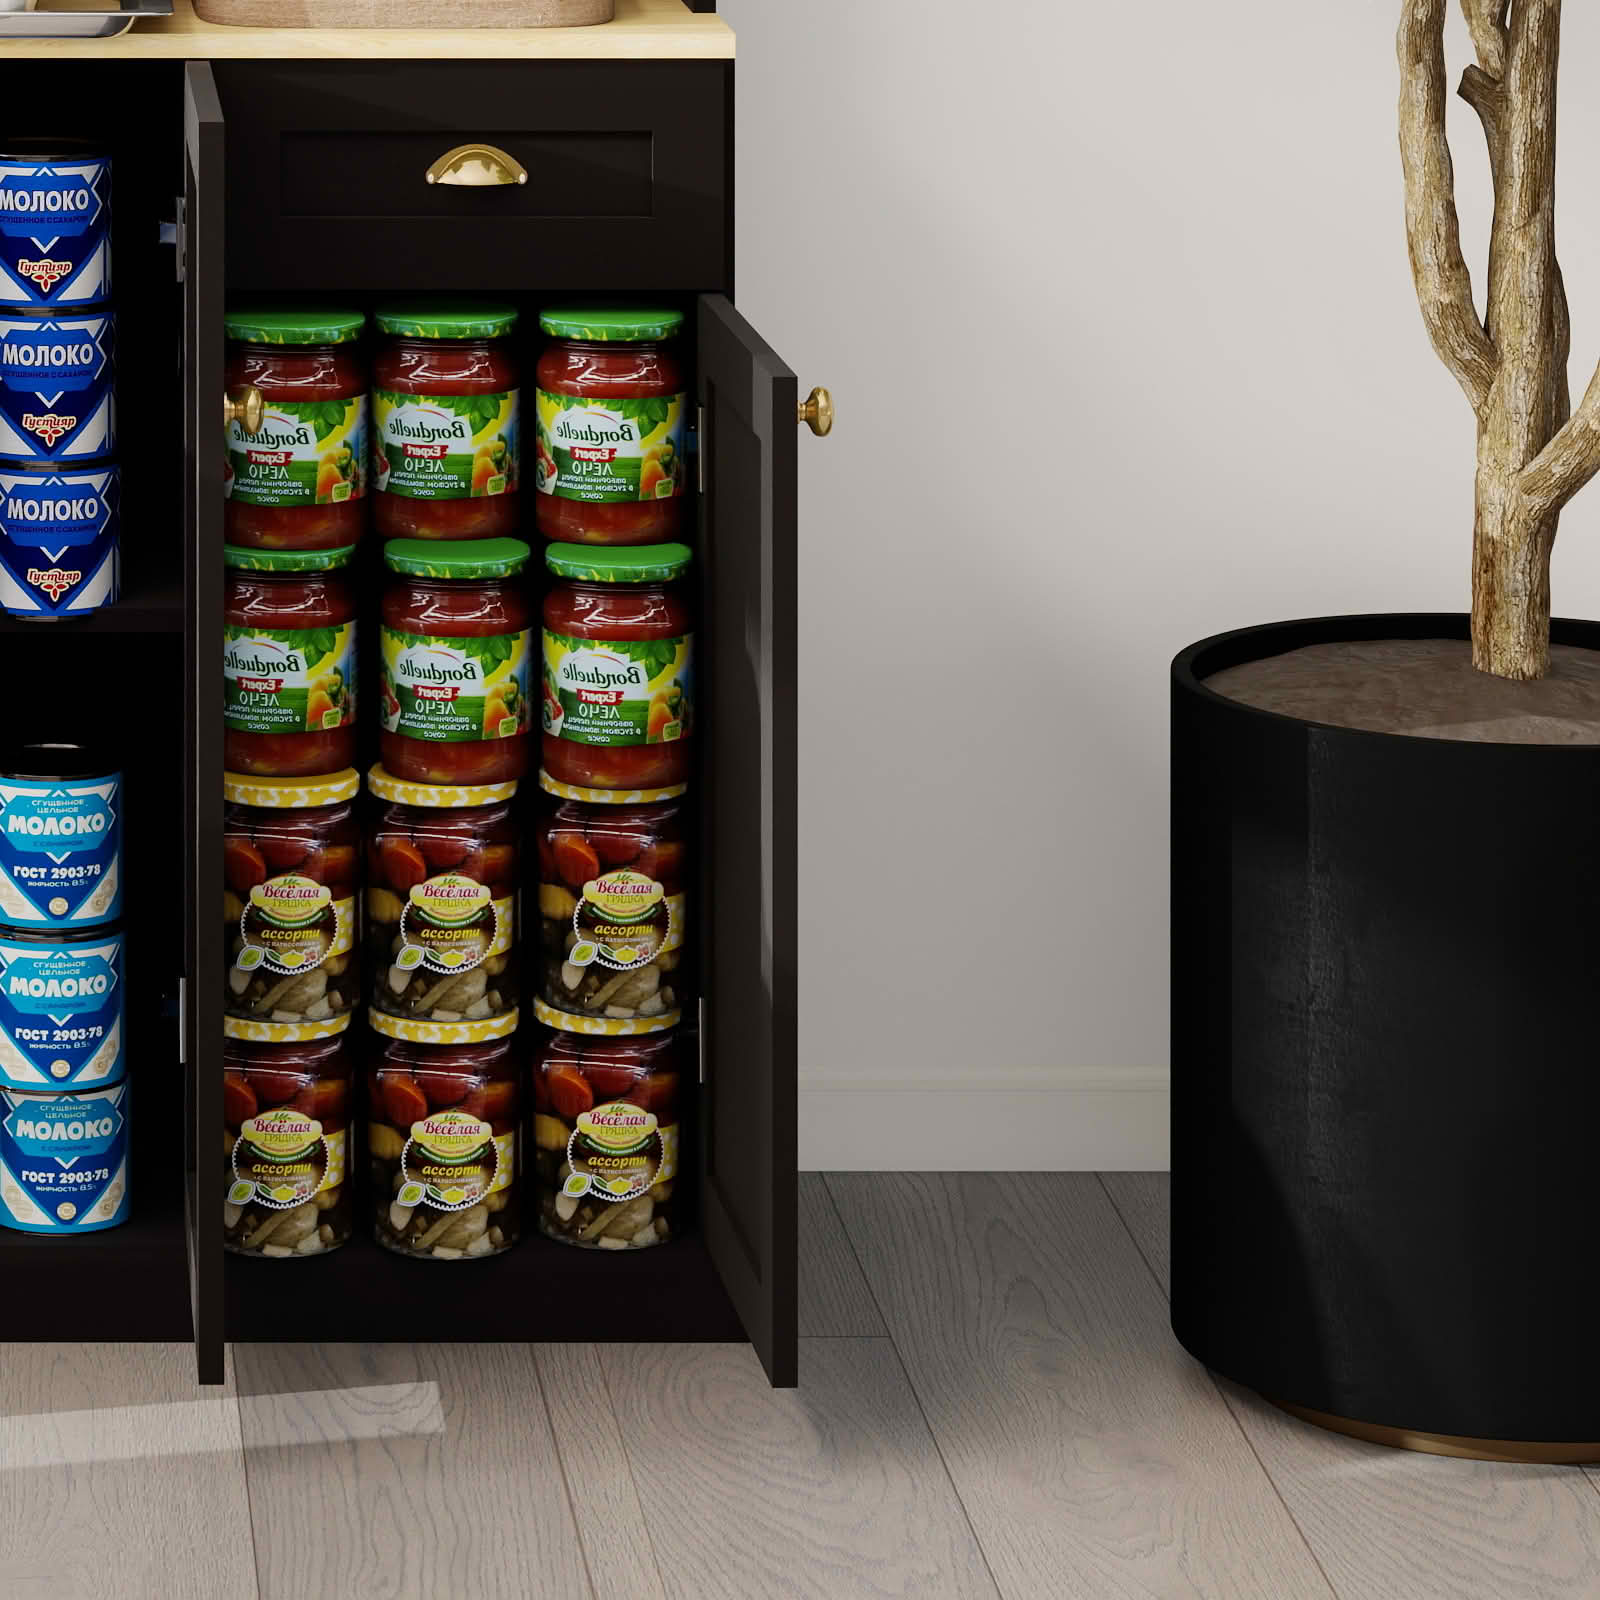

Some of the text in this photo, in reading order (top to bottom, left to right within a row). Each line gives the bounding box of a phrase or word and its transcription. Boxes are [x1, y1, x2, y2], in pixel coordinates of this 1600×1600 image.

[20, 259, 71, 276] Густияр
[3, 343, 94, 367] МОЛОКО
[24, 414, 75, 431] Густияр
[7, 497, 98, 521] МОЛОКО
[29, 568, 80, 585] Густияр
[7, 812, 105, 835] МОЛОКО
[13, 865, 47, 879] ГОСТ
[262, 885, 320, 899] Весёлая
[422, 884, 480, 898] Весёлая
[595, 880, 653, 894] Весёлая
[260, 929, 320, 942] ассорти
[420, 928, 480, 941] ассорти
[593, 924, 653, 937] ассорти
[9, 974, 107, 997] МОЛОКО
[14, 1027, 49, 1041] ГОСТ
[253, 1119, 311, 1133] Весёлая
[589, 1112, 647, 1126] Весёлая
[15, 1117, 113, 1140] МОЛОКО
[423, 1121, 481, 1135] Весёлая
[251, 1163, 311, 1176] ассорти
[587, 1156, 647, 1169] ассорти
[21, 1170, 55, 1184] ГОСТ
[421, 1165, 481, 1178] ассорти
